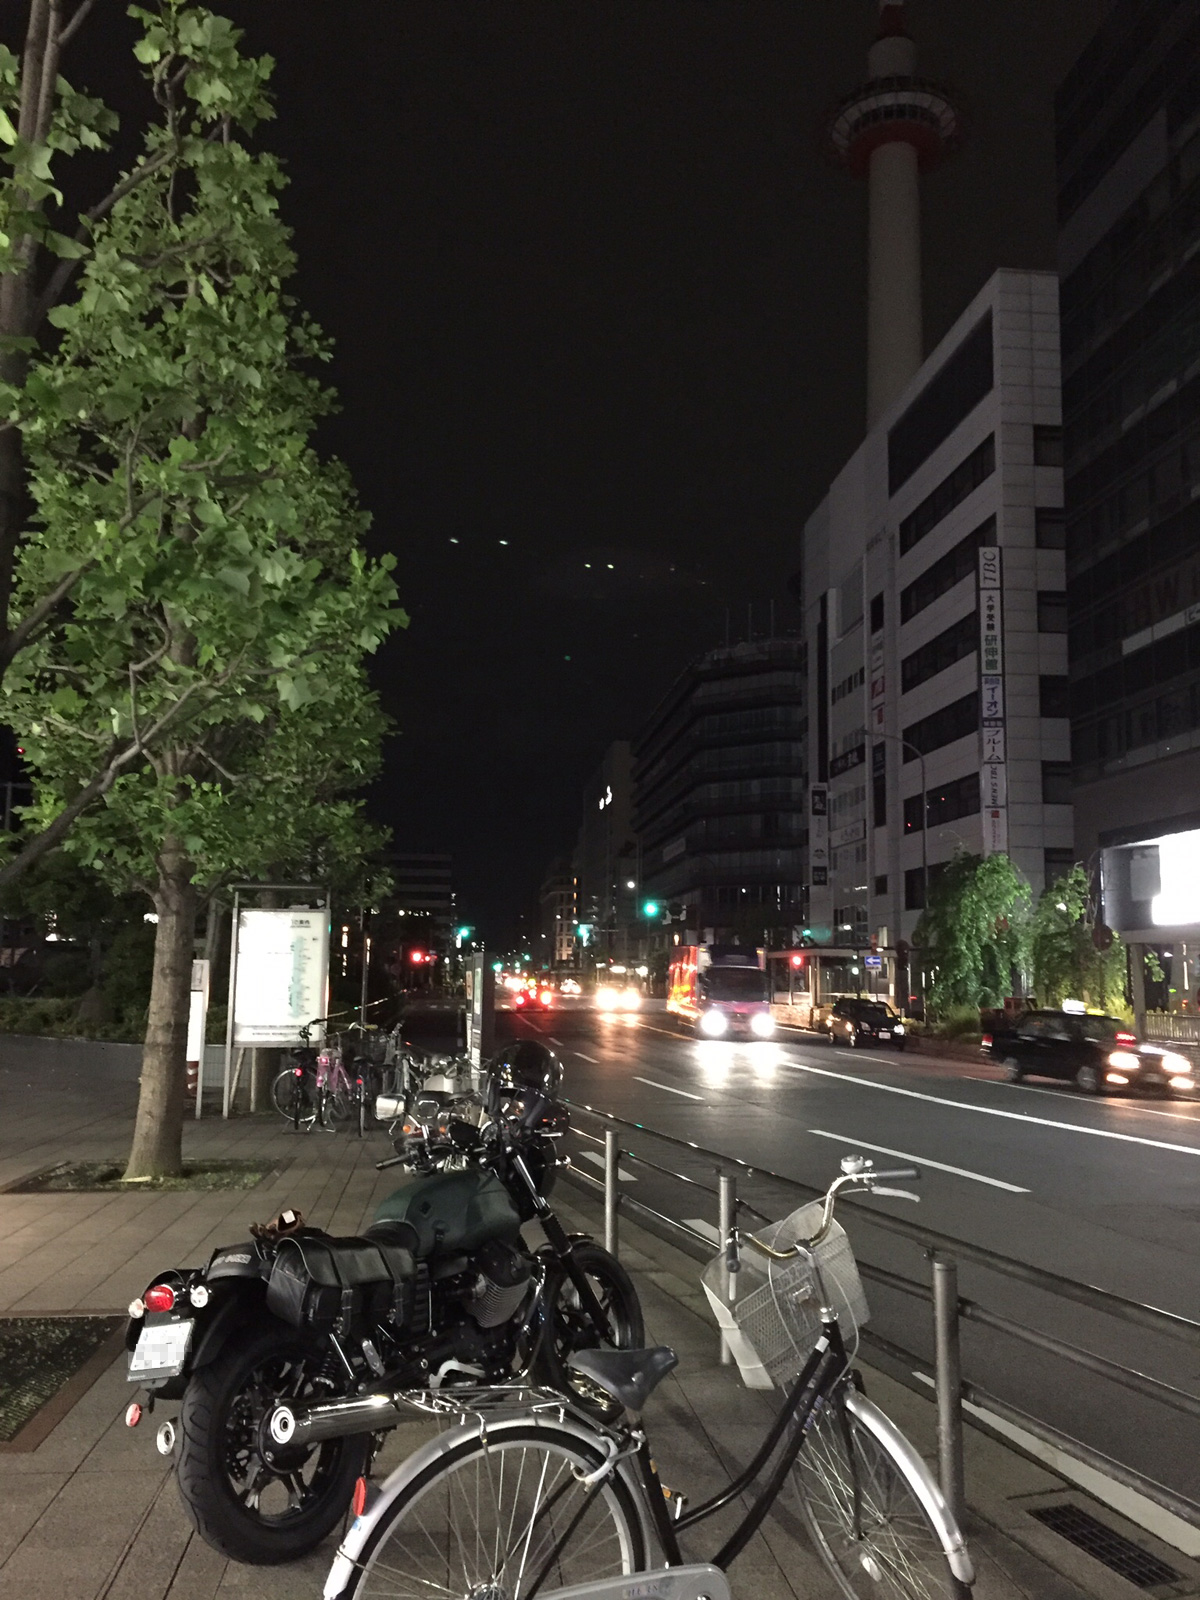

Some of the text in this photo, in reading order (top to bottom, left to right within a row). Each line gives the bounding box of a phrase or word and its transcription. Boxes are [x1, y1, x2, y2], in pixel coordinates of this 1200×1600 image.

[983, 551, 997, 583] TBC
[985, 686, 999, 717] イーオン
